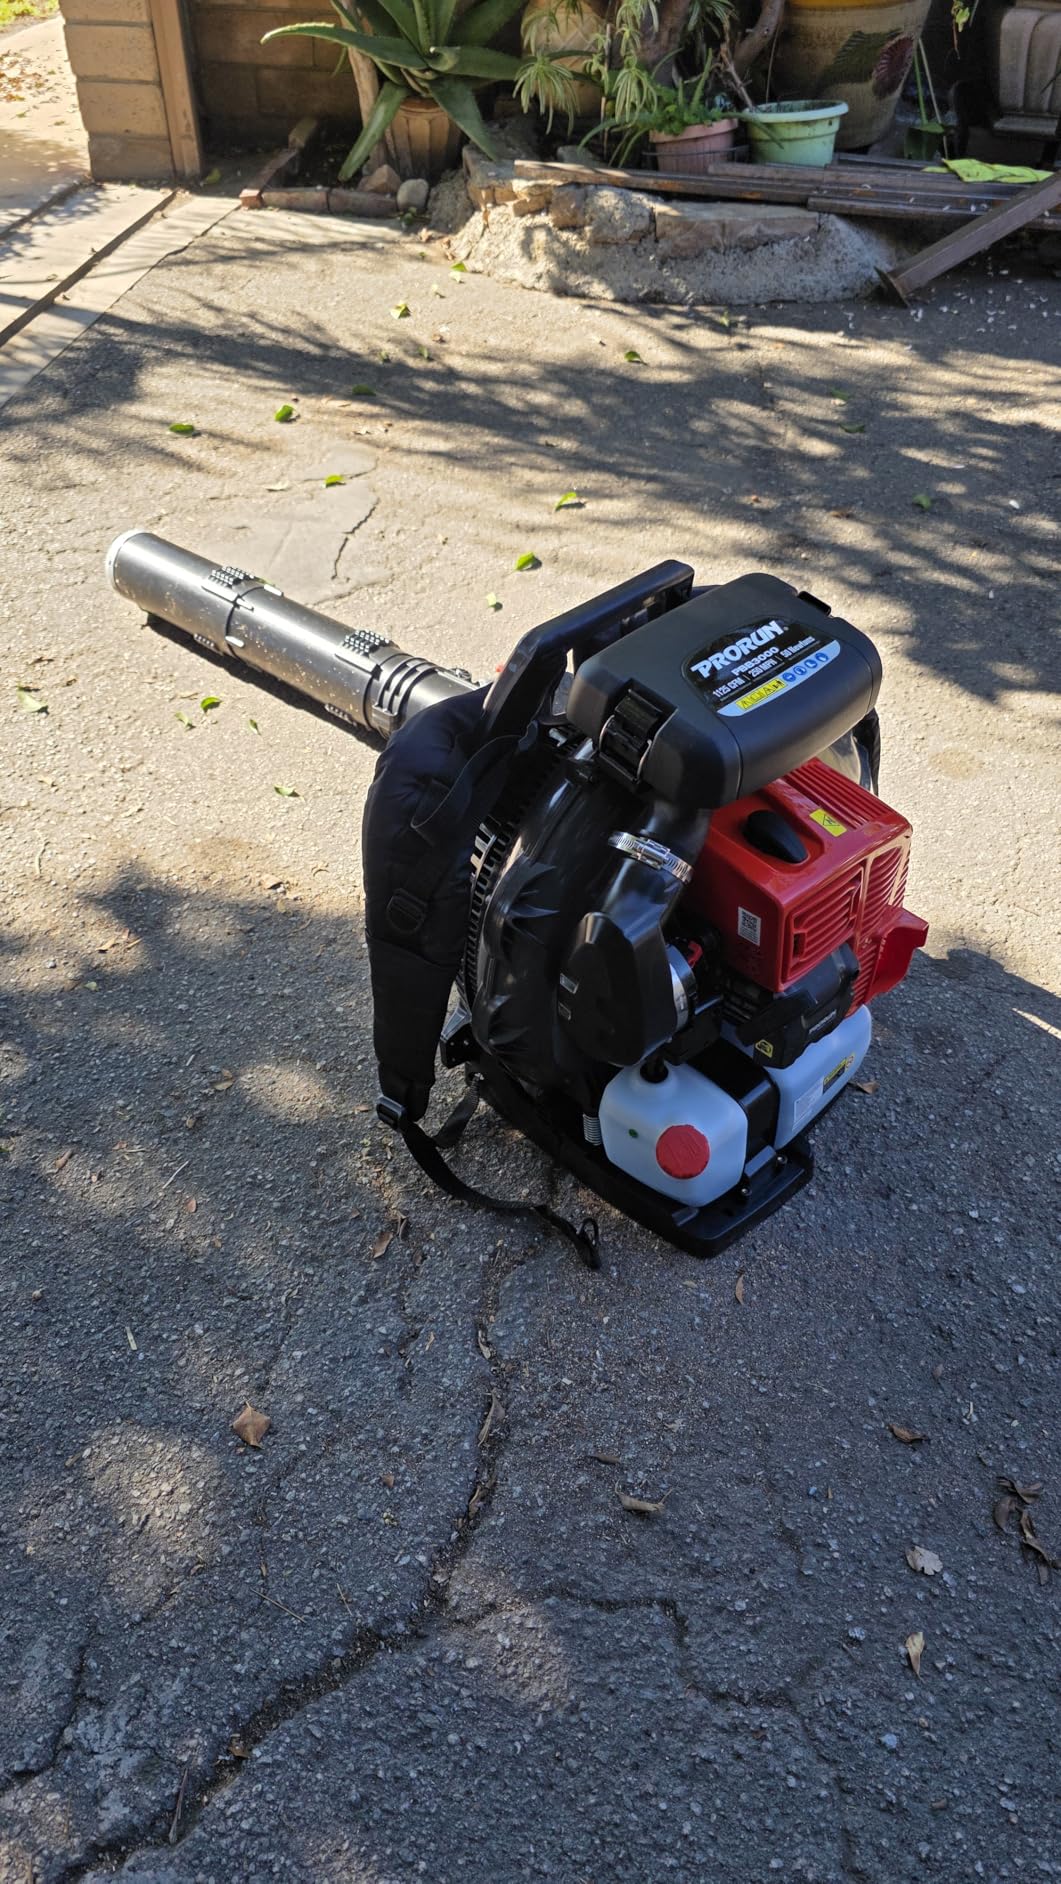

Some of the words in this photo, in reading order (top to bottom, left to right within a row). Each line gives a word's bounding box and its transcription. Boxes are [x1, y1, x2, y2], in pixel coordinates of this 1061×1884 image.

[690, 620, 784, 678] PRORUN
[731, 646, 780, 676] PBB3000
[712, 683, 731, 698] 1125
[727, 677, 745, 690] CFM
[748, 667, 763, 677] 250
[760, 658, 778, 671] MPH
